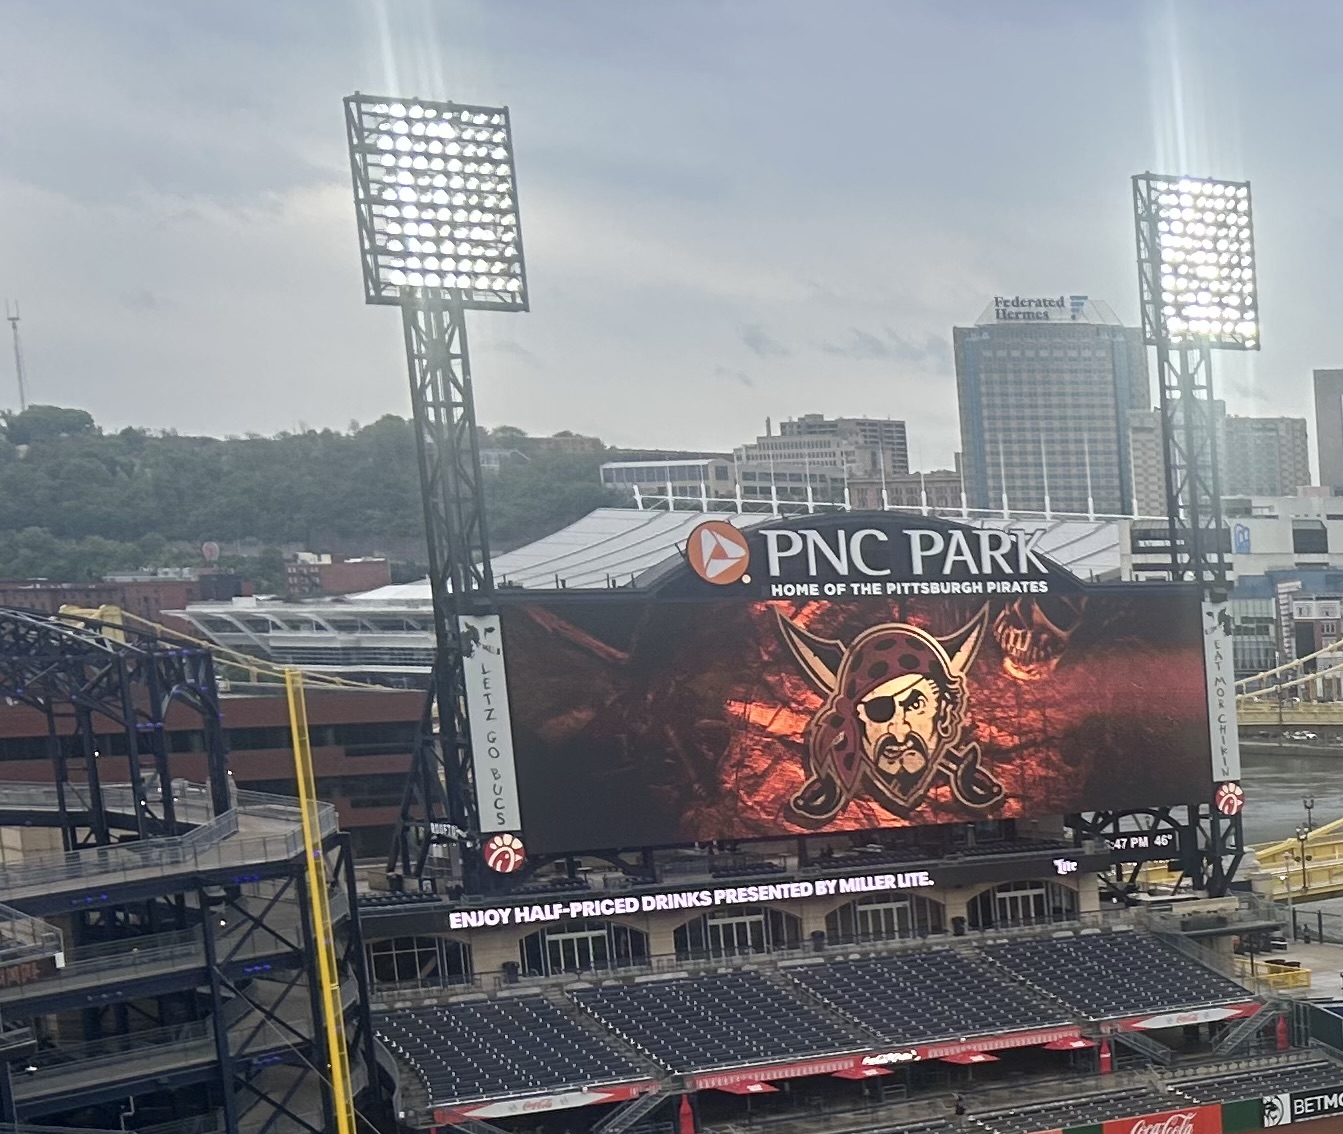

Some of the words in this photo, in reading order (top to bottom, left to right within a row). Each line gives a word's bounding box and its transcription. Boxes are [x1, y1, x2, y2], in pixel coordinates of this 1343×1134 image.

[994, 296, 1065, 308] Federated
[995, 308, 1050, 320] Hermes
[758, 529, 891, 577] PNC
[902, 528, 1049, 575] PARK
[771, 583, 819, 597] HOME
[824, 583, 846, 595] OF
[851, 583, 882, 595] THE
[887, 582, 983, 595] PITTSBURGH
[986, 580, 1048, 594] PIRATES
[1213, 639, 1223, 671] EAT
[481, 663, 496, 722] LETZ
[1214, 676, 1226, 709] MOR
[487, 730, 500, 759] GO
[1217, 714, 1230, 777] CHIKIN
[490, 767, 505, 826] BUCS
[1130, 837, 1148, 848] PM
[449, 908, 512, 929] ENJOY
[515, 898, 639, 923] HALF-PRICED
[642, 890, 712, 911] DRINKS
[714, 882, 813, 905] PRESENTED
[815, 879, 837, 896] BY
[839, 874, 896, 893] MILLER
[897, 871, 934, 889] LITE.
